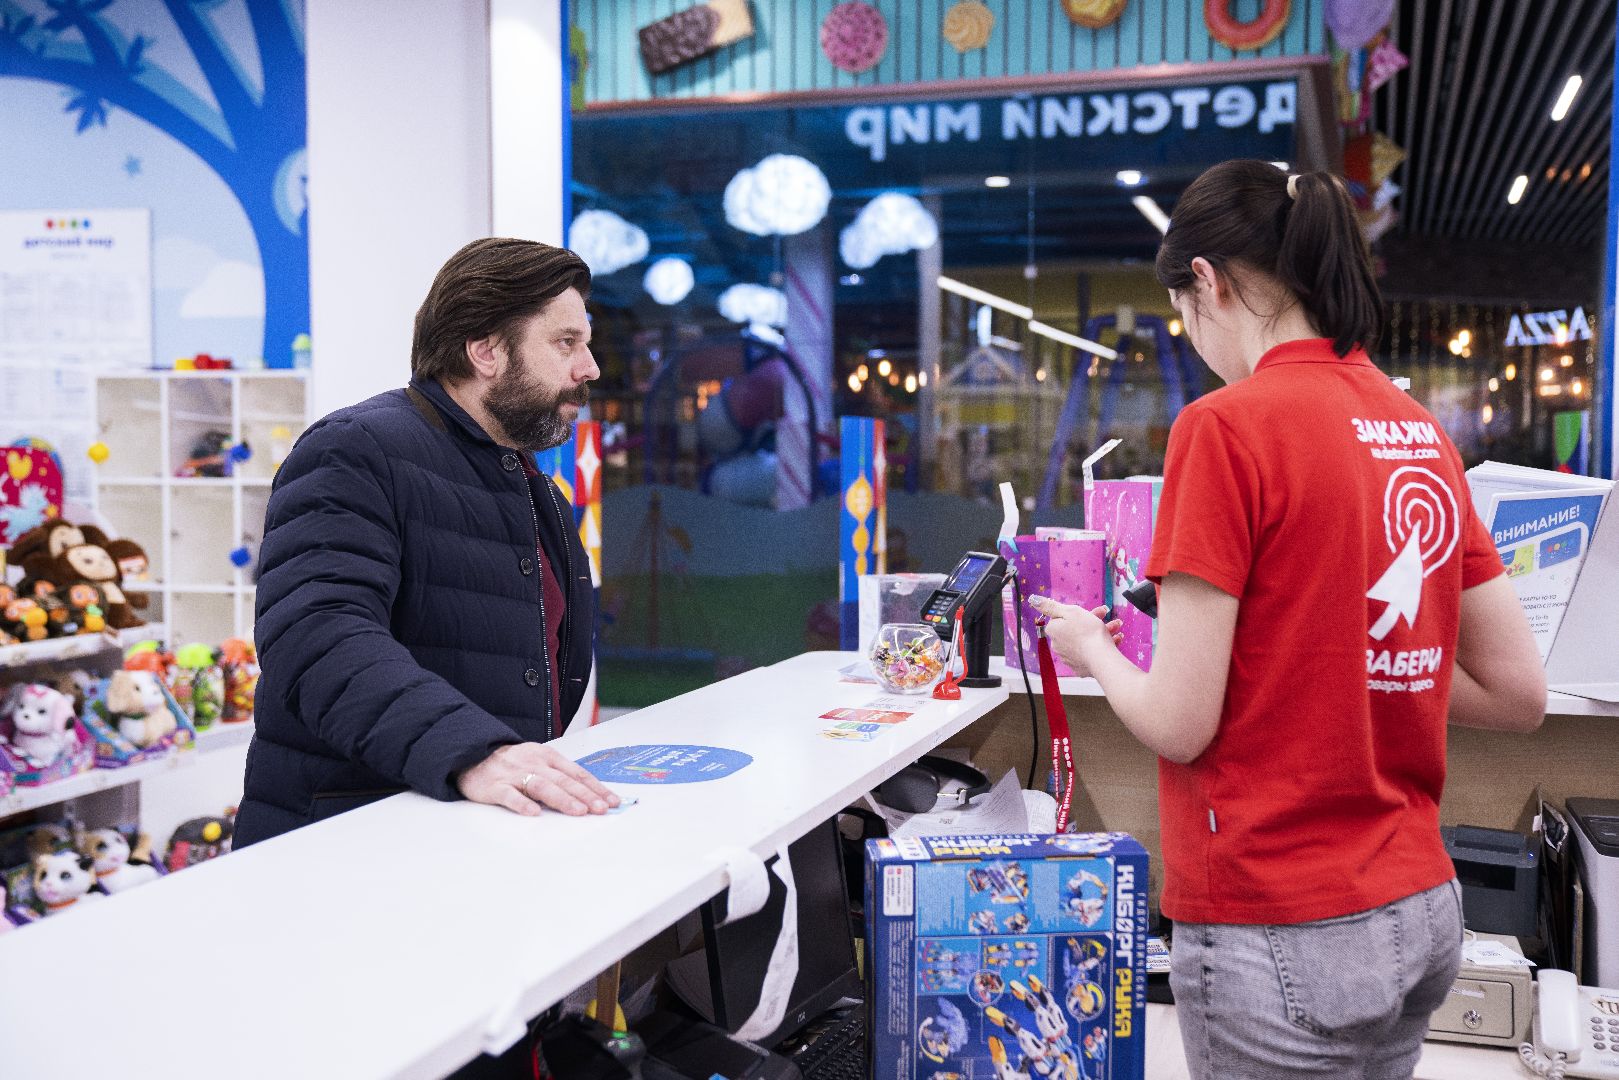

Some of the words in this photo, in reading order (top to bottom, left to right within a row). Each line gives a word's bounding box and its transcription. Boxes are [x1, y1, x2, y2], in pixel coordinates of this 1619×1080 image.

[1351, 417, 1441, 445] ЗАКАЖИ
[1494, 504, 1580, 544] ВНИМАНИЕ!
[1366, 679, 1408, 694] овары
[1114, 967, 1133, 1038] РУКА
